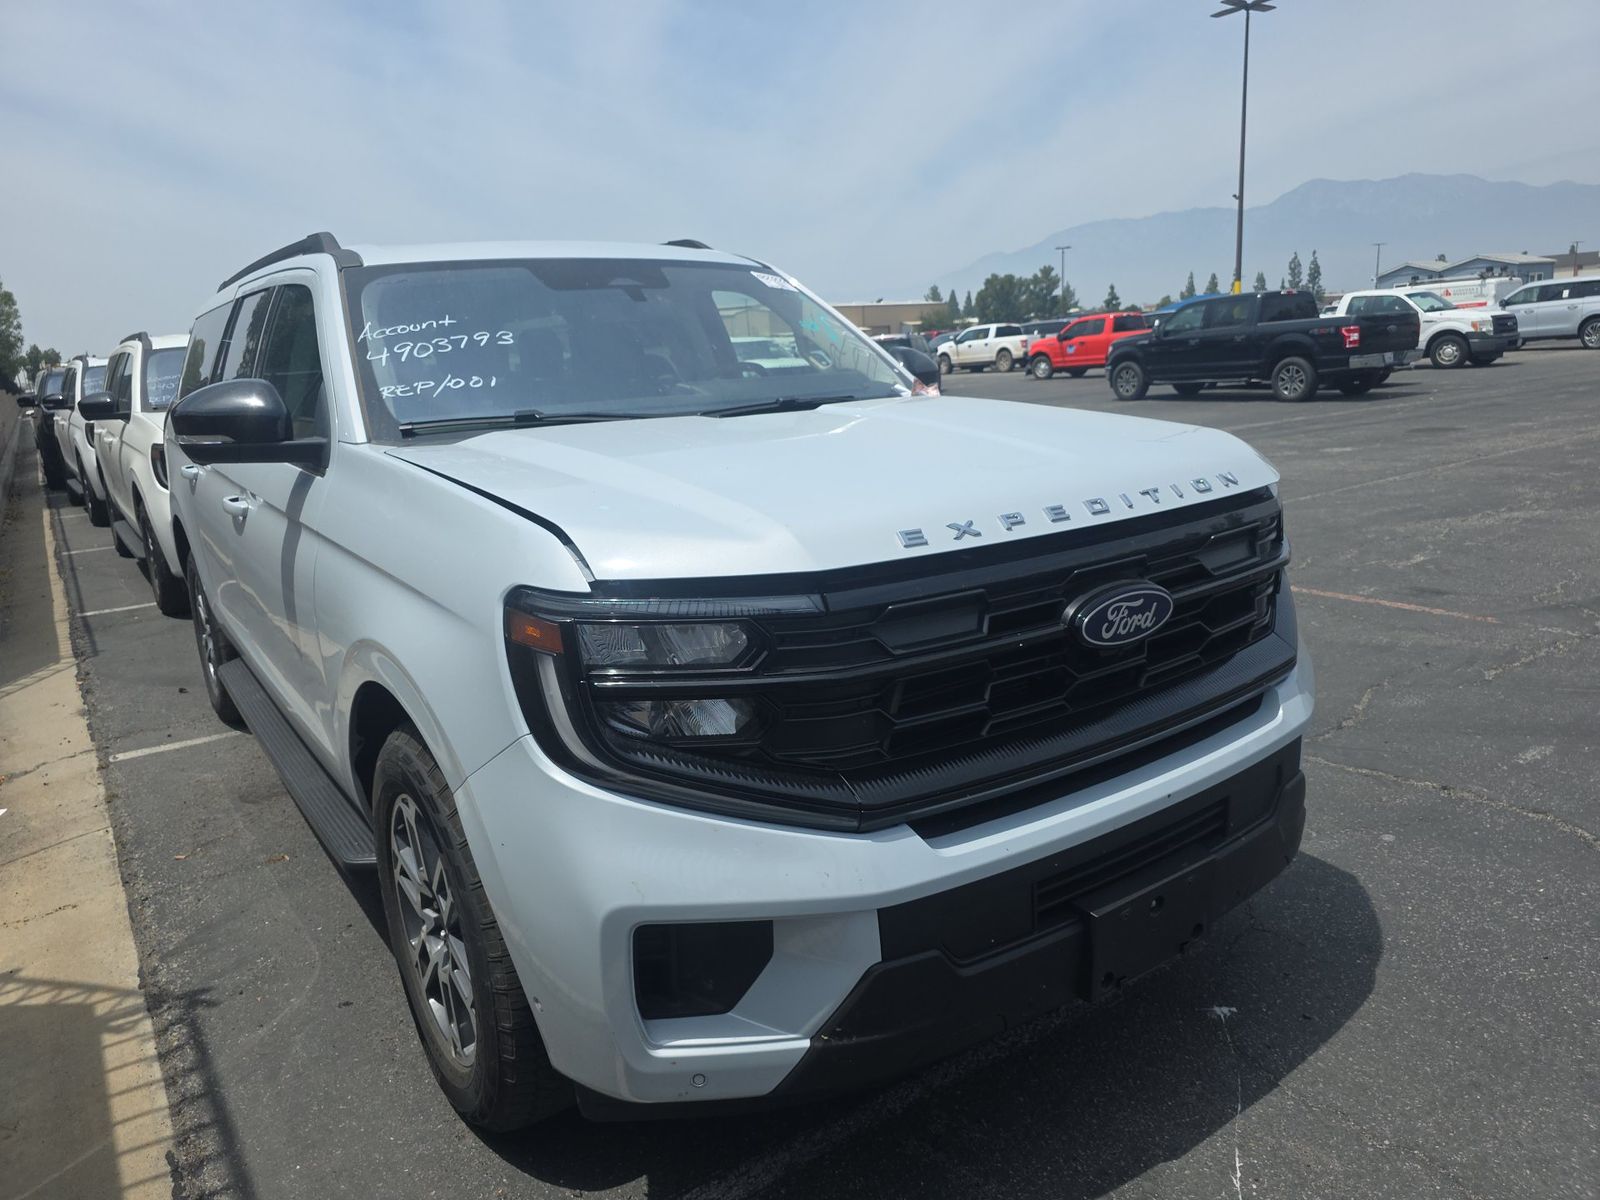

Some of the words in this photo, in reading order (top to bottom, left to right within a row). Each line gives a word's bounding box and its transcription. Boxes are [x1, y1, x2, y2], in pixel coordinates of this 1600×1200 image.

[366, 331, 515, 367] 4903793
[896, 471, 1240, 549] EXPEDITION
[1101, 598, 1158, 640] Ford
